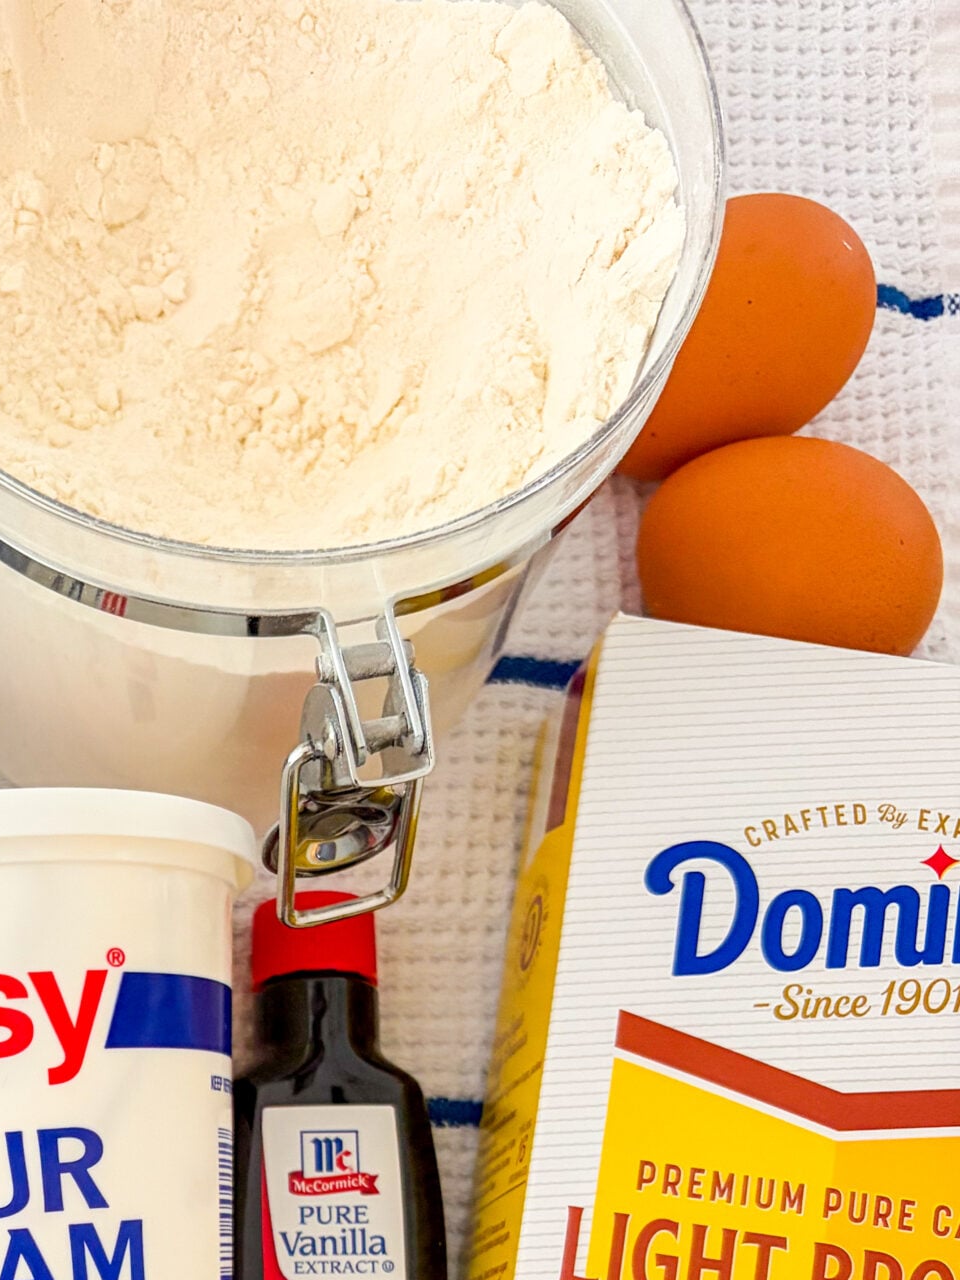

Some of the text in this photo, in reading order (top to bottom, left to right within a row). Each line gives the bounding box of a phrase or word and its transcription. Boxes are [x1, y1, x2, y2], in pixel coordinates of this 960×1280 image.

[292, 1175, 369, 1193] McCormick
[298, 1205, 369, 1225] PURE
[279, 1228, 388, 1256] Vanilla
[294, 1261, 378, 1274] EXTRACT
